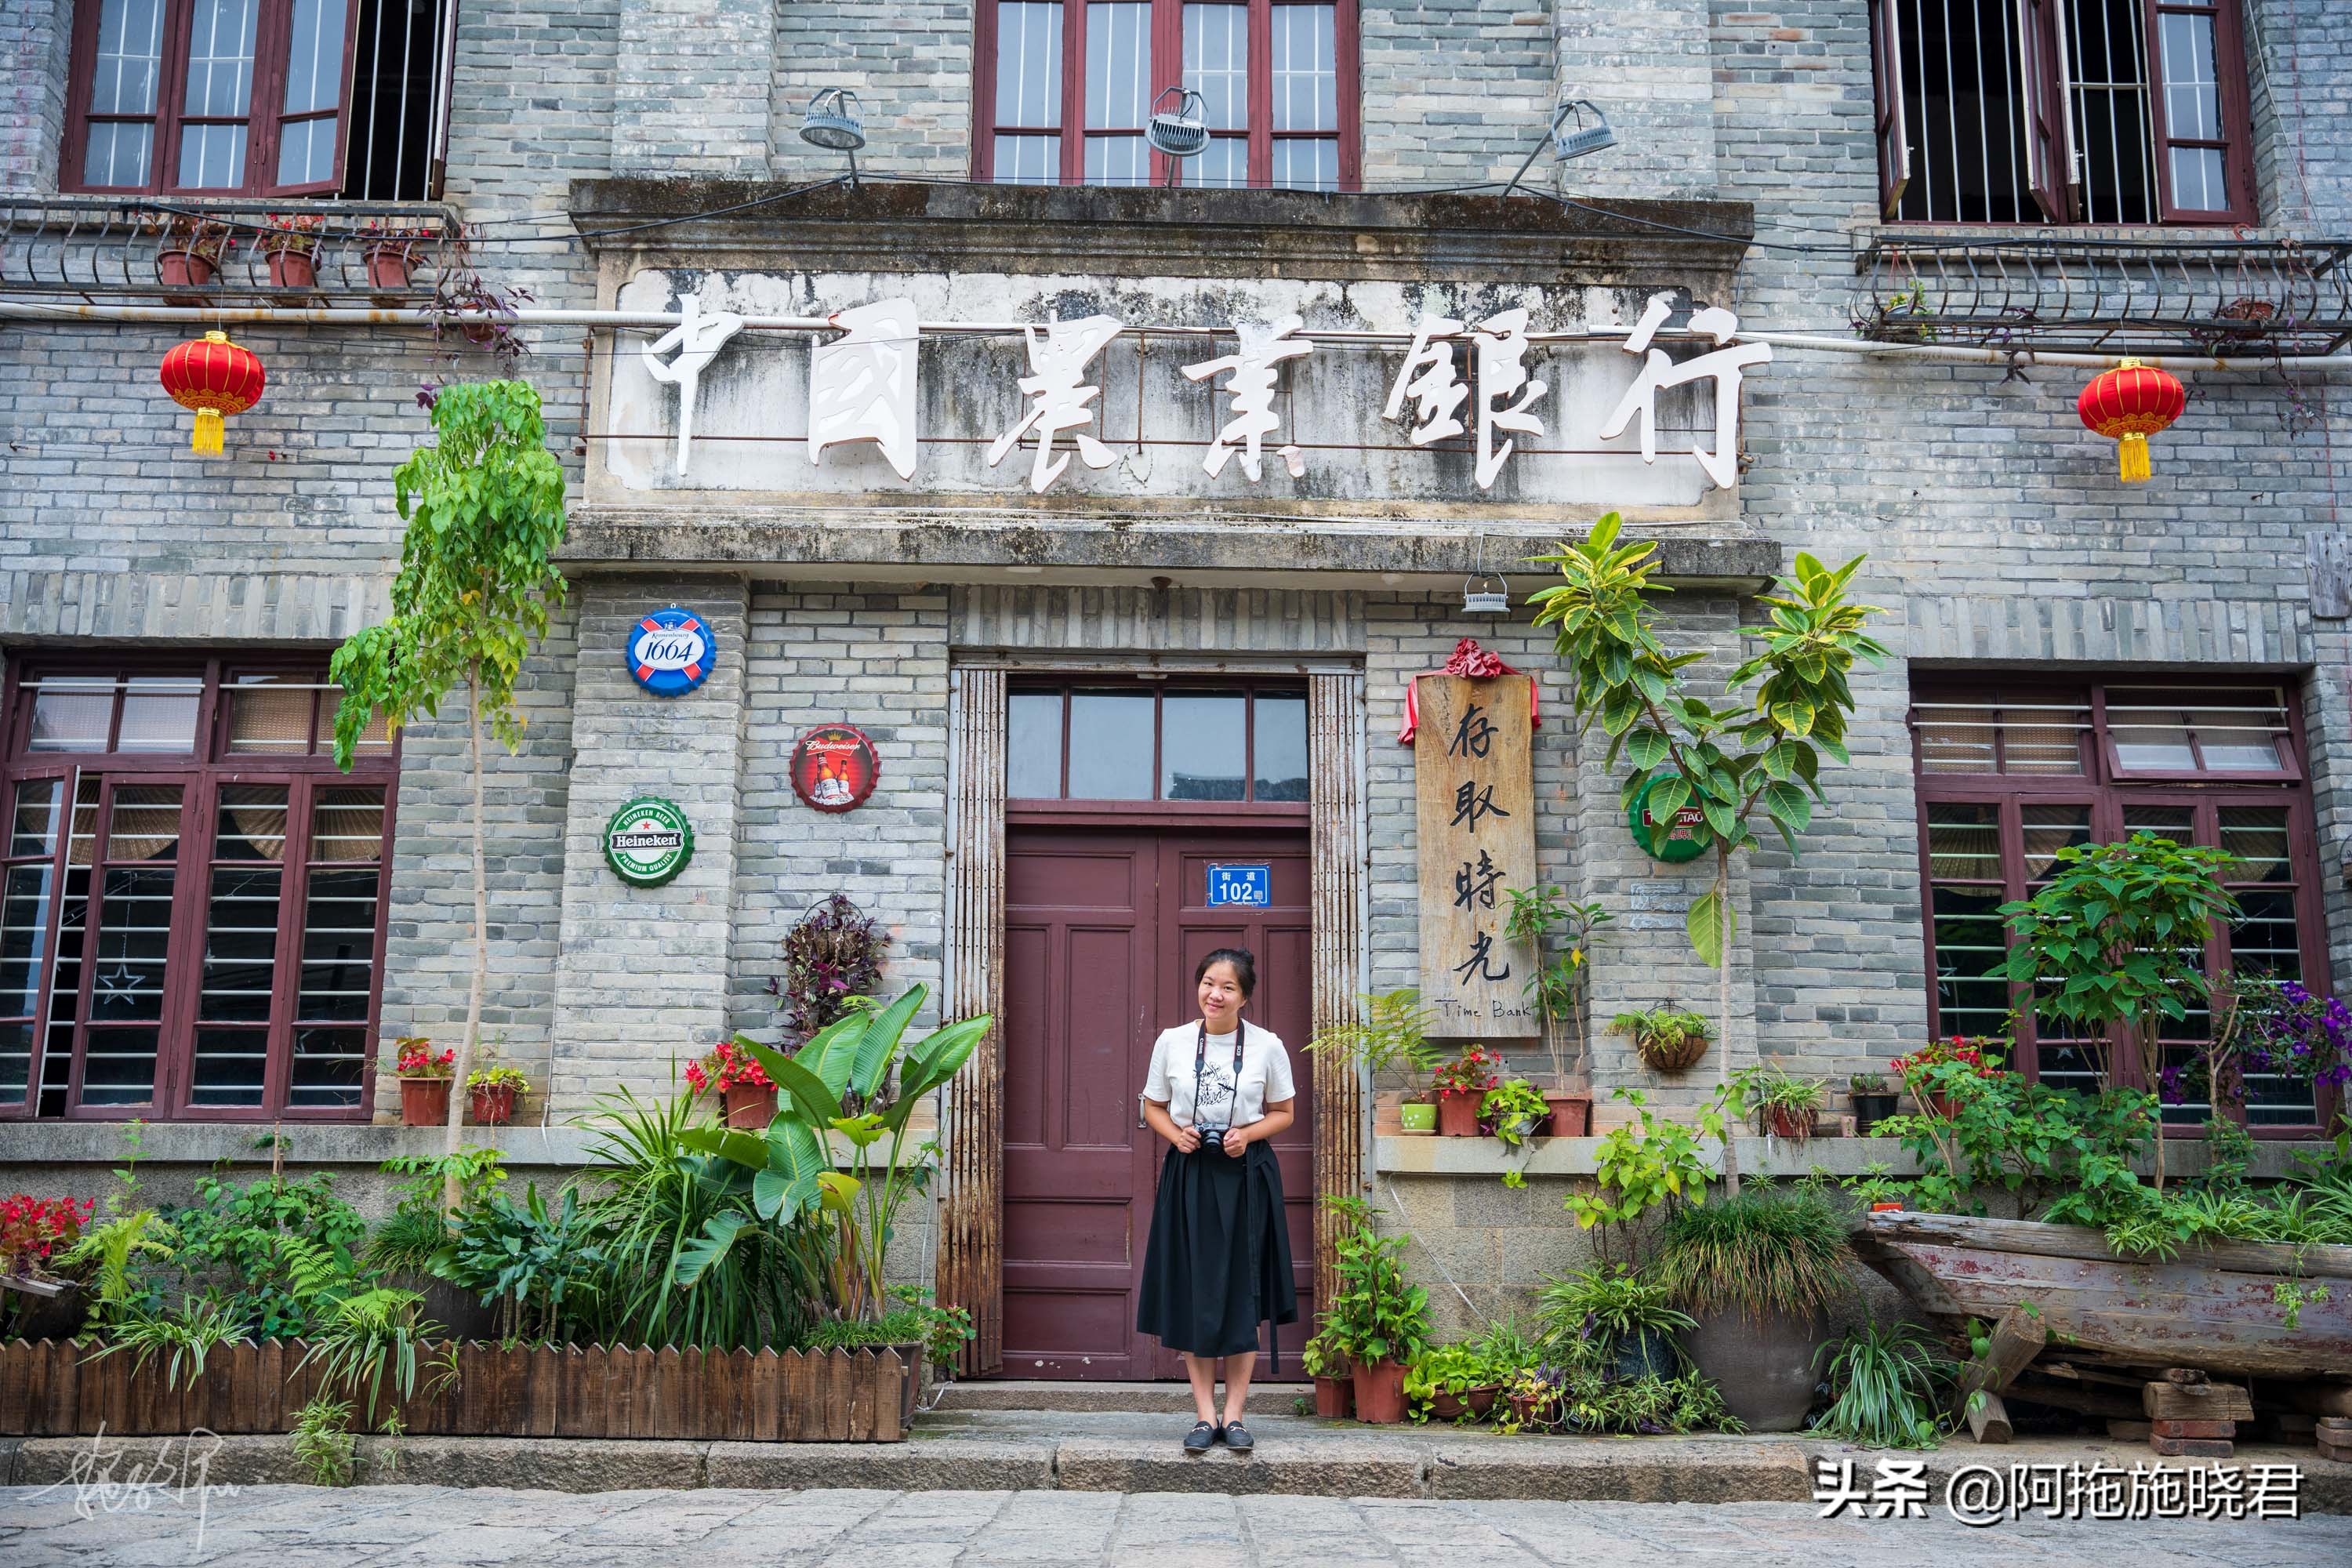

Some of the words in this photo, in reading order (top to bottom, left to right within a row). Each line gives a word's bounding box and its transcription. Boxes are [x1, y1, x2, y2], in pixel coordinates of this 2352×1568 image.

[644, 638, 695, 662] 1664
[805, 740, 861, 750] Budweiser
[622, 809, 654, 826] HEINEKEN
[655, 811, 670, 825] BEER
[616, 834, 677, 848] Heineken
[1449, 702, 1510, 986] 存取時光
[620, 855, 648, 872] PREMIUM
[649, 854, 673, 871] QUALITY
[1219, 883, 1253, 901] 102
[1434, 999, 1482, 1018] Time
[1492, 999, 1531, 1018] Bank
